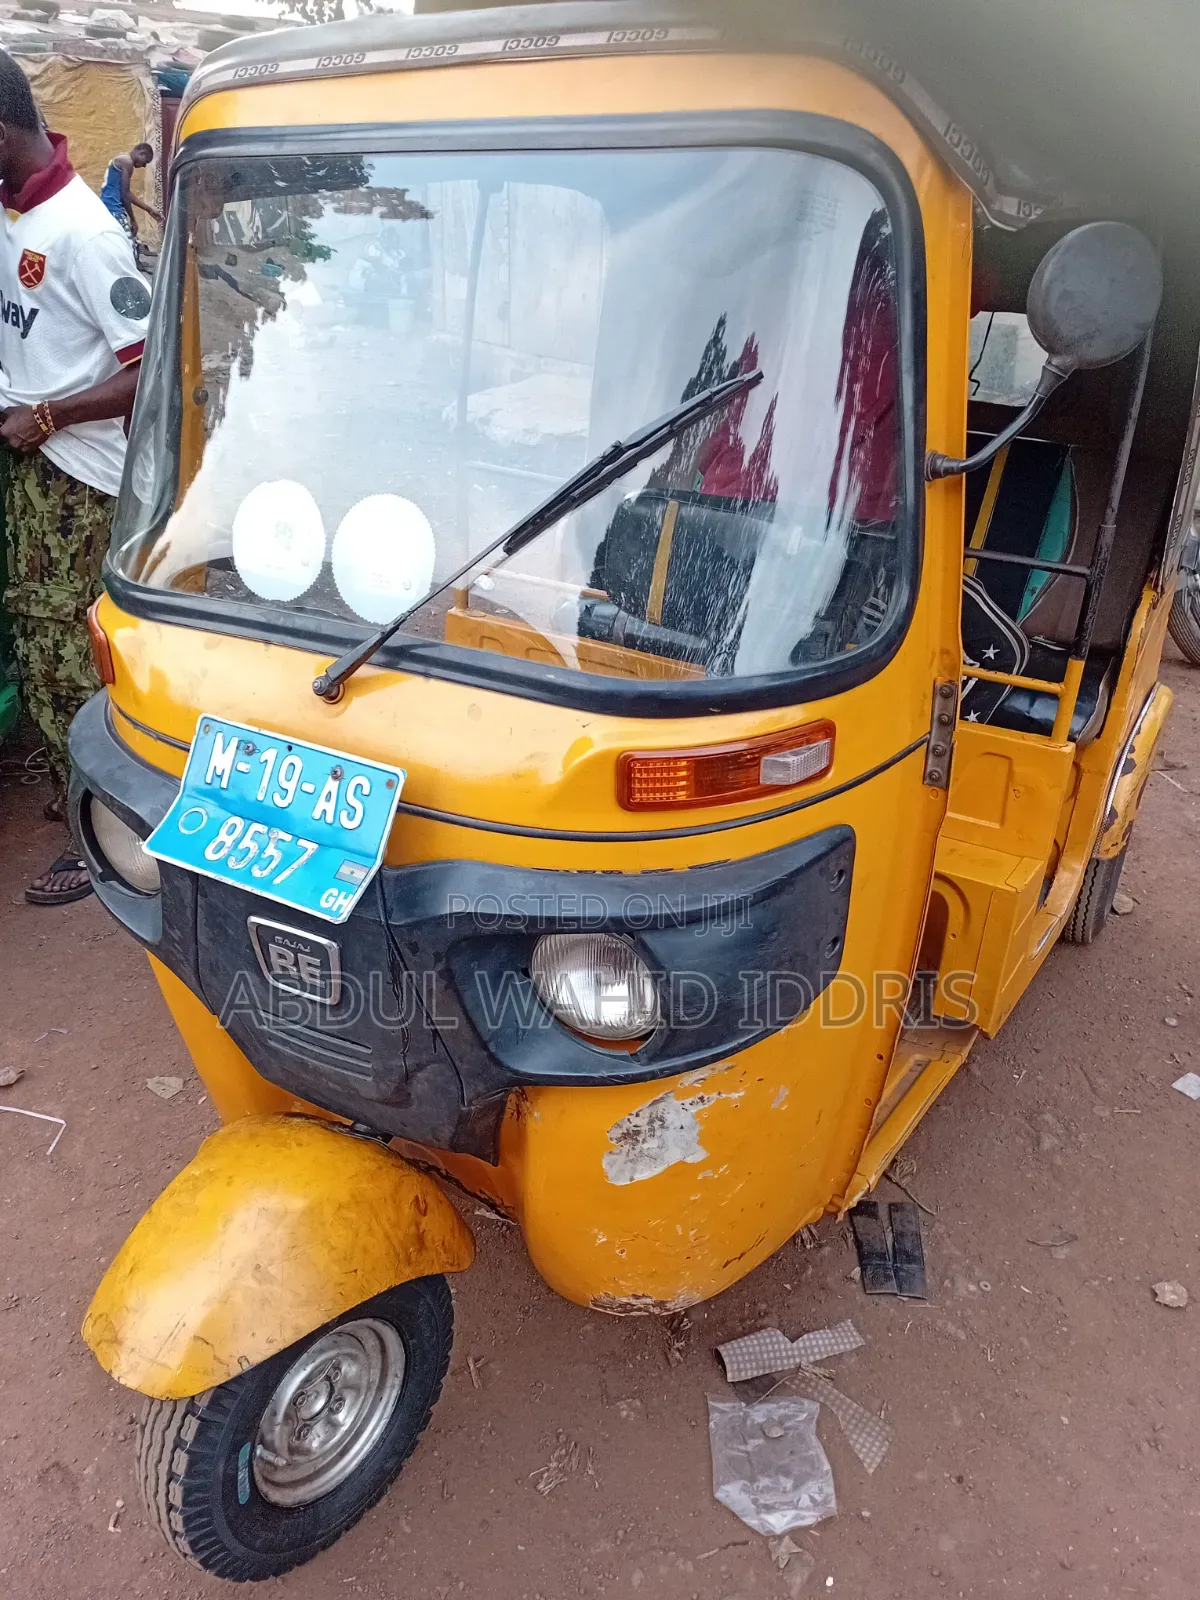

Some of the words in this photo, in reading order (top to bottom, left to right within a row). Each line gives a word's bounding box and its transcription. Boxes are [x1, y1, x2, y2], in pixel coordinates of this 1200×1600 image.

[233, 62, 280, 79] GOCCI
[316, 52, 367, 69] GOCCI
[405, 44, 459, 59] GOCCI
[502, 35, 561, 51] GOCCI
[606, 28, 670, 44] GOCCI
[0, 289, 40, 340] way
[204, 732, 372, 830] M-19-AS
[203, 816, 319, 885] 8557
[319, 888, 354, 914] GH
[268, 943, 327, 989] RE
